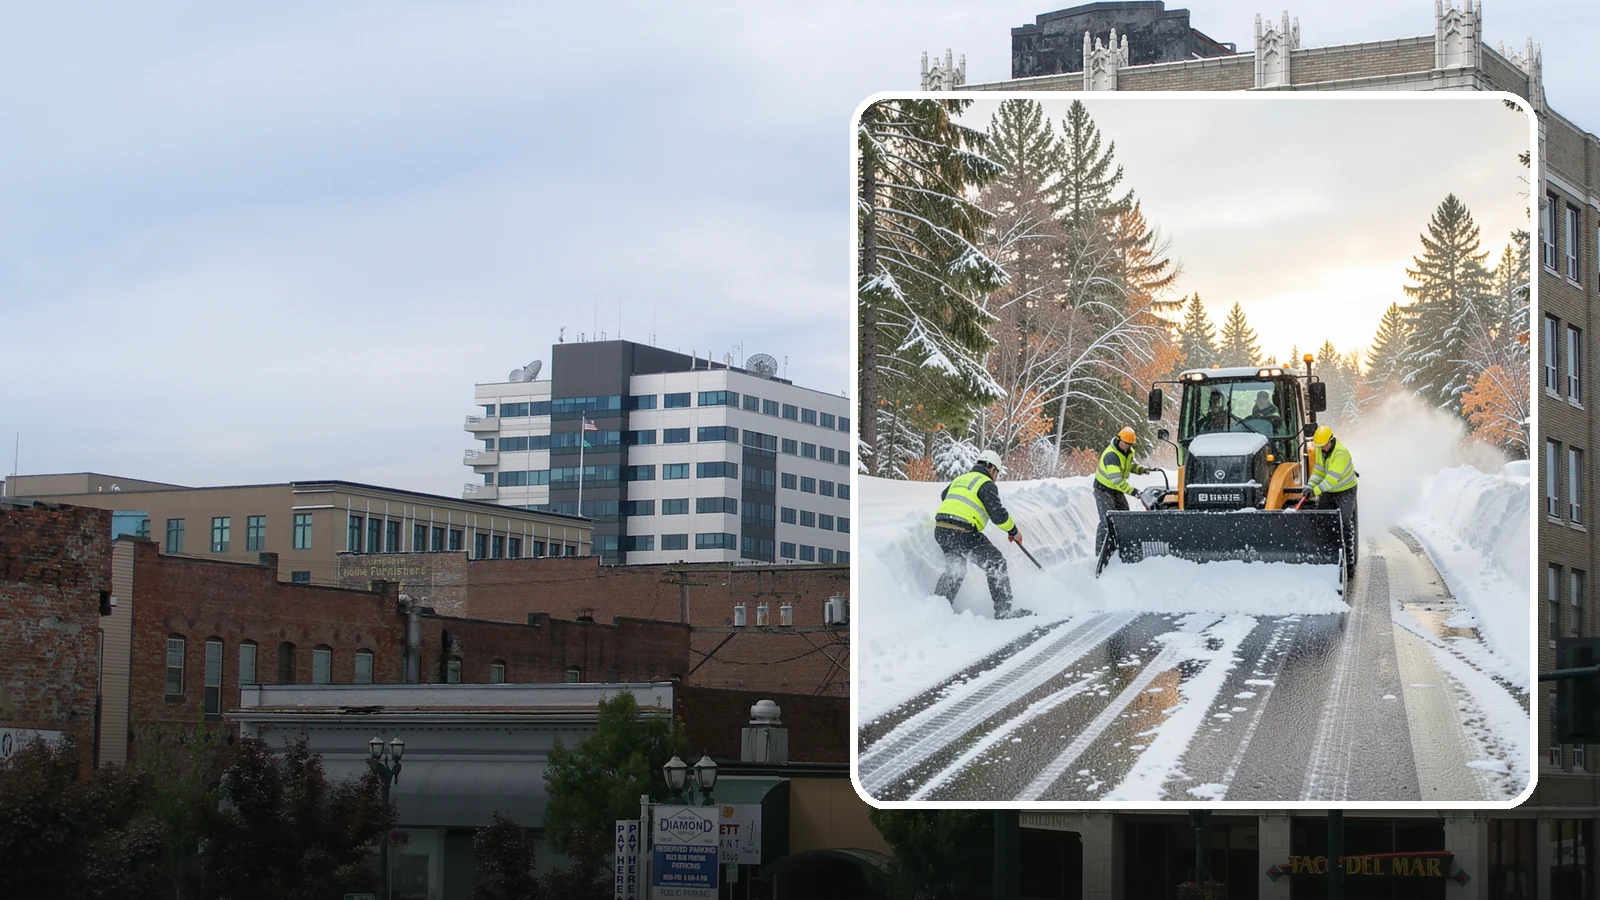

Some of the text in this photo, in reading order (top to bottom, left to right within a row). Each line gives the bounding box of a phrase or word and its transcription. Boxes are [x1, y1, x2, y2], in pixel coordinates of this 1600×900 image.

[343, 566, 426, 577] Home Furnishers
[660, 818, 713, 832] DIAMOND
[1022, 815, 1069, 828] BUILDING
[655, 845, 716, 854] RESERVED PARKING
[722, 852, 739, 862] Soup
[671, 862, 701, 870] PATRONS
[1346, 856, 1385, 875] DEL
[1392, 857, 1443, 877] MAR
[616, 855, 625, 893] HERE
[627, 855, 636, 893] HERE
[660, 889, 710, 898] PUBLIC PARKING
